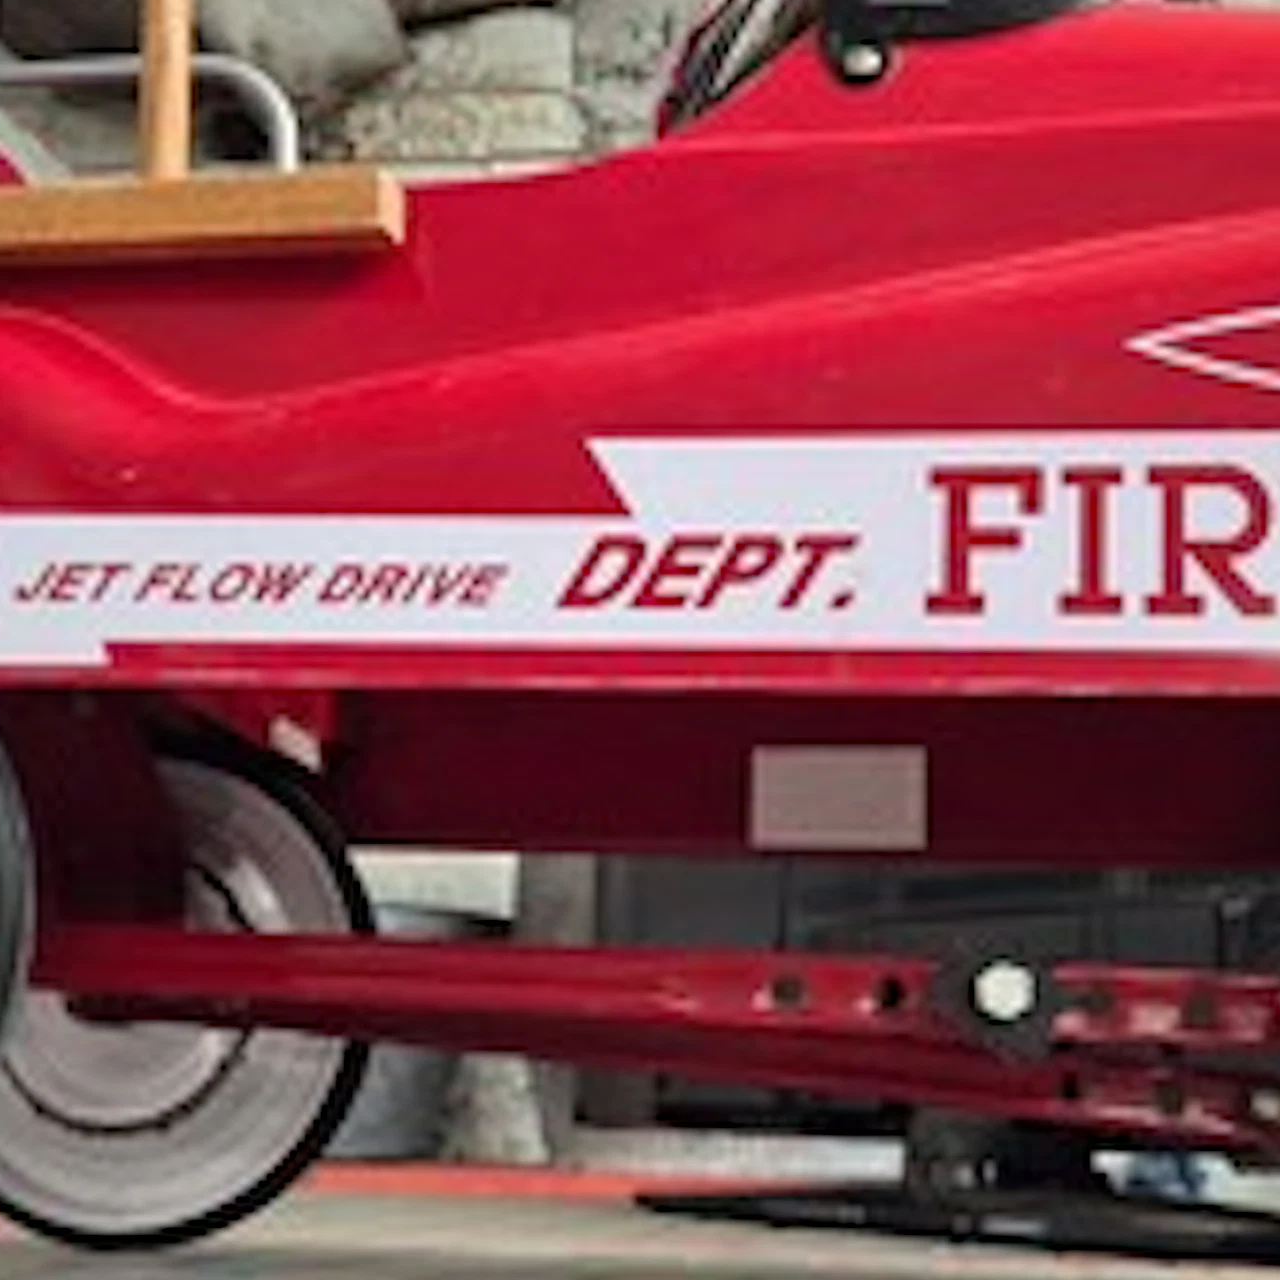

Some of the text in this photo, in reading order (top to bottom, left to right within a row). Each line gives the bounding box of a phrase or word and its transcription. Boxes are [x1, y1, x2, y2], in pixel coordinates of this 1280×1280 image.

[15, 562, 507, 607] JET FLOW DRIVE
[556, 533, 860, 609] DEPT.
